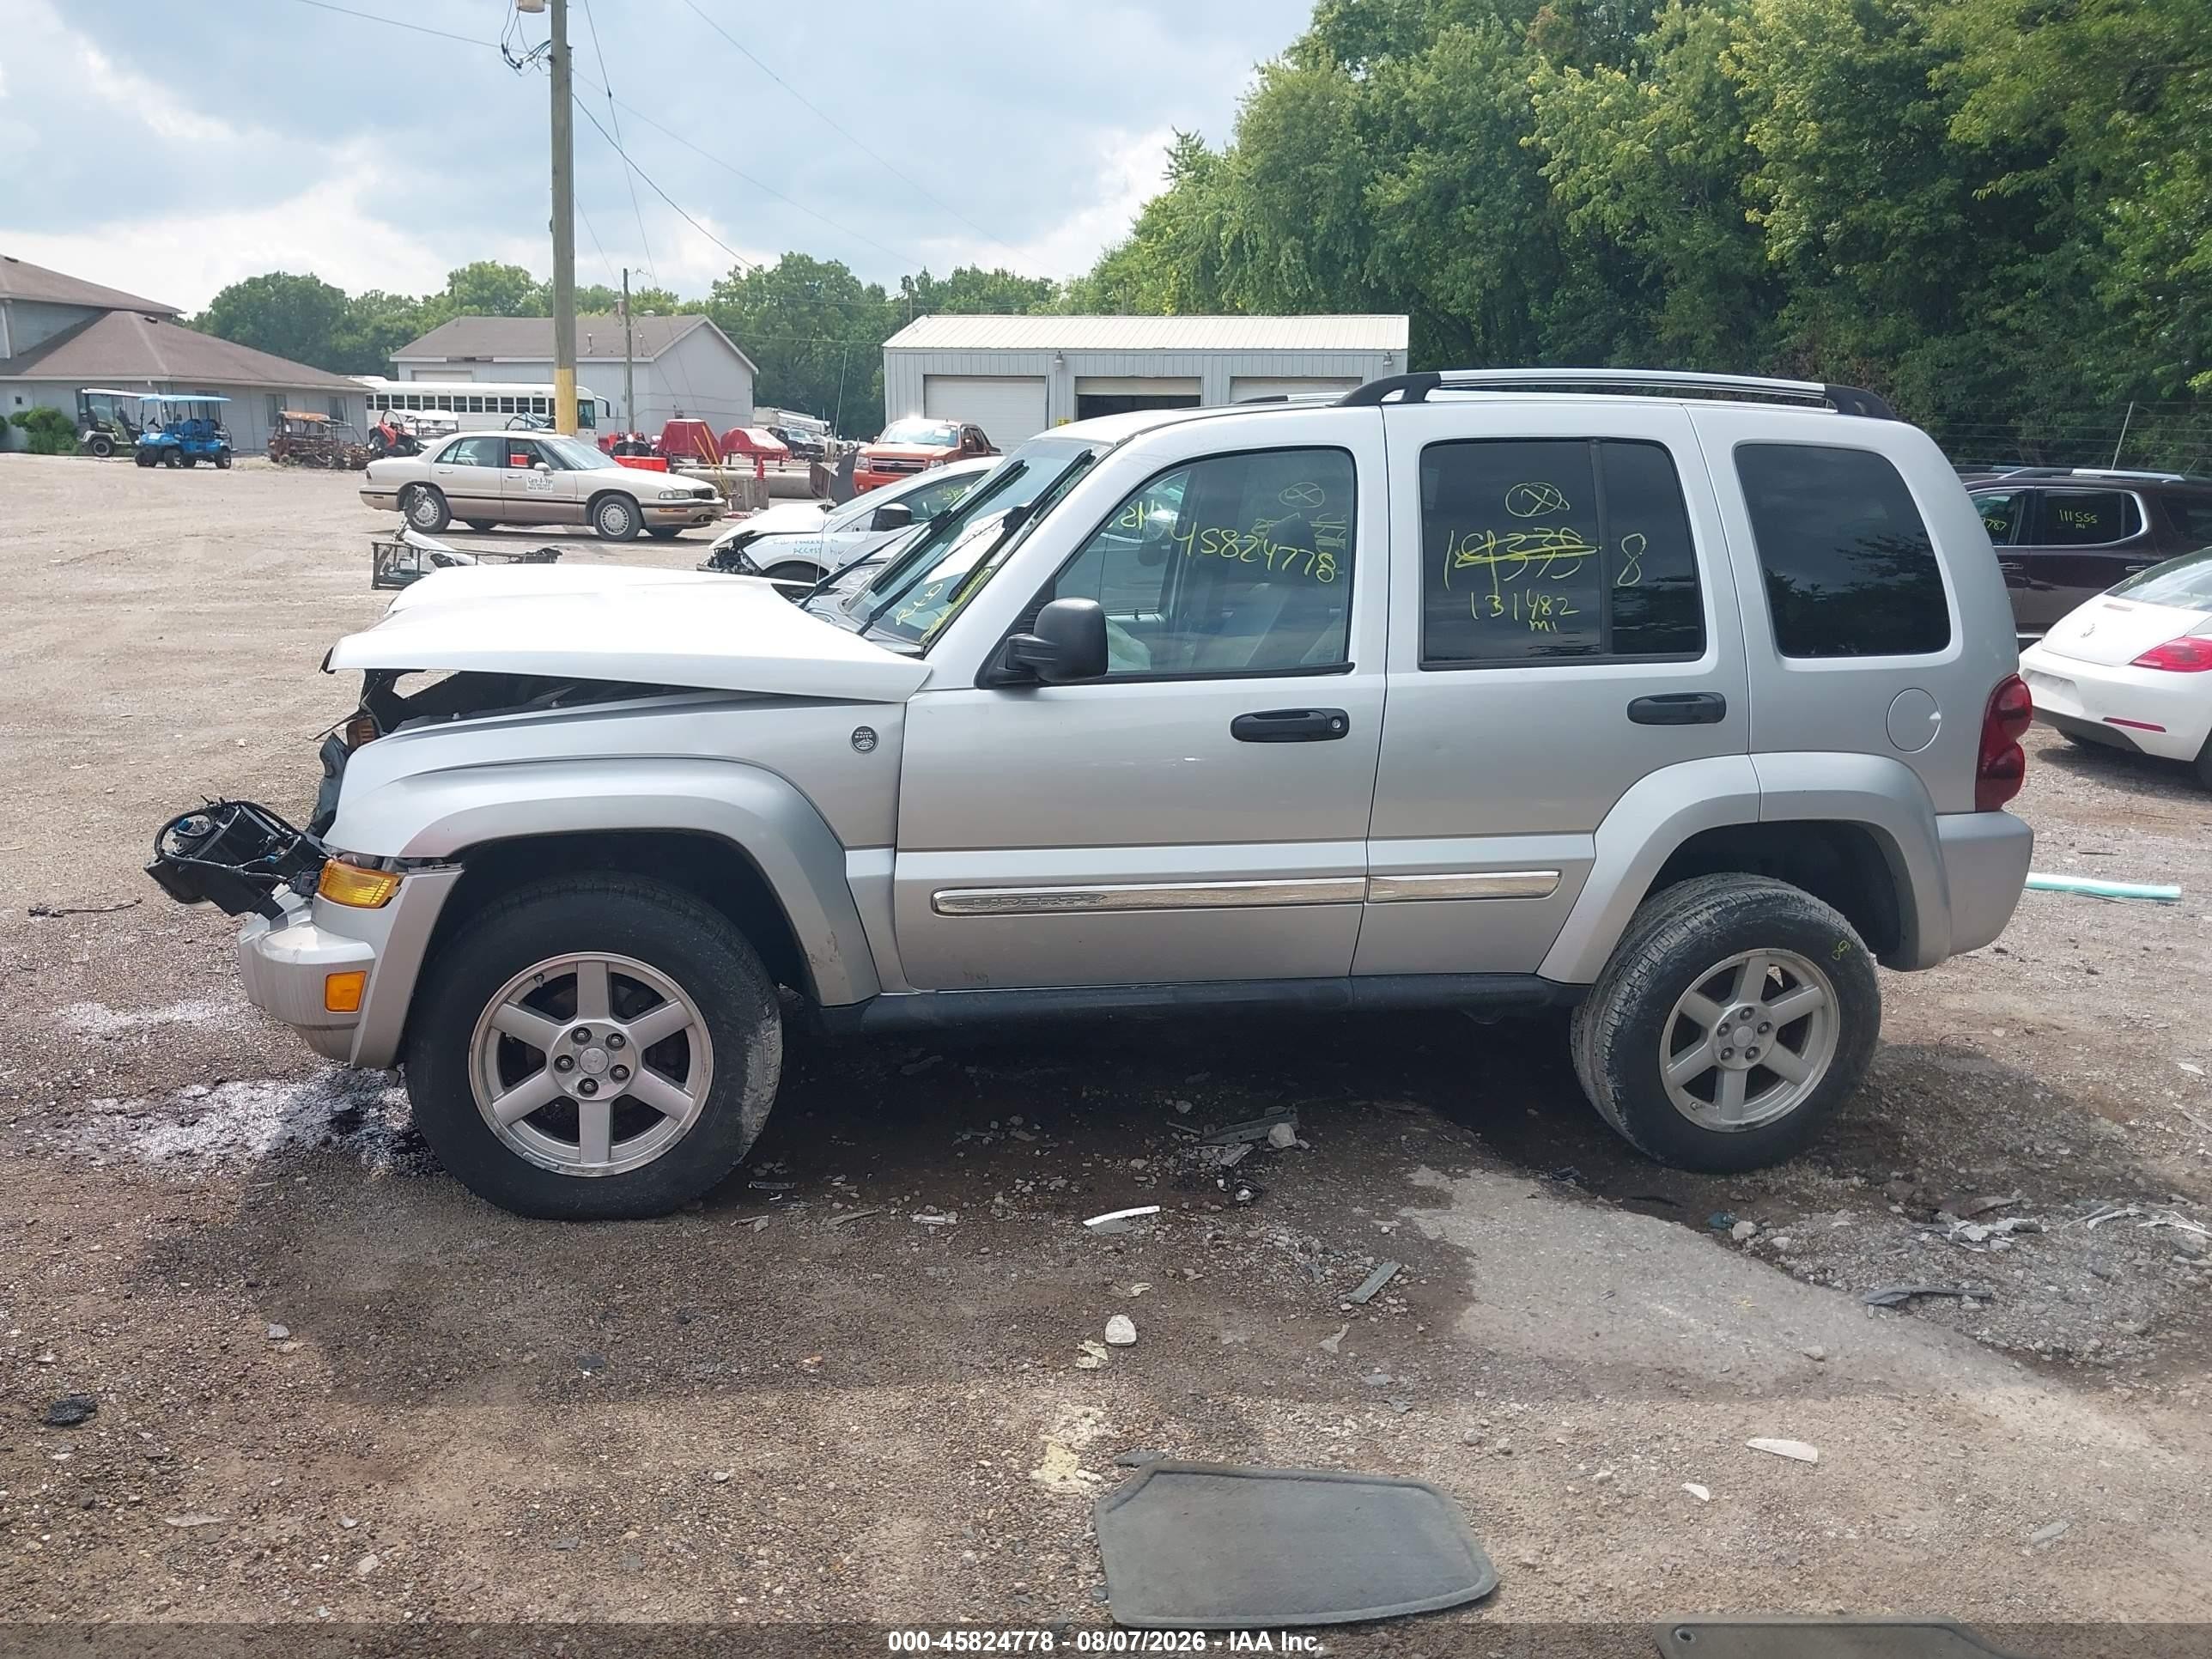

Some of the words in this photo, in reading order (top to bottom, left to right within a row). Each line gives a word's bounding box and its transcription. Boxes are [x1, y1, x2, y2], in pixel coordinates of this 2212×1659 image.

[1170, 516, 1336, 583] 45824778
[1617, 532, 1647, 586] 8
[1470, 588, 1581, 622] 131482
